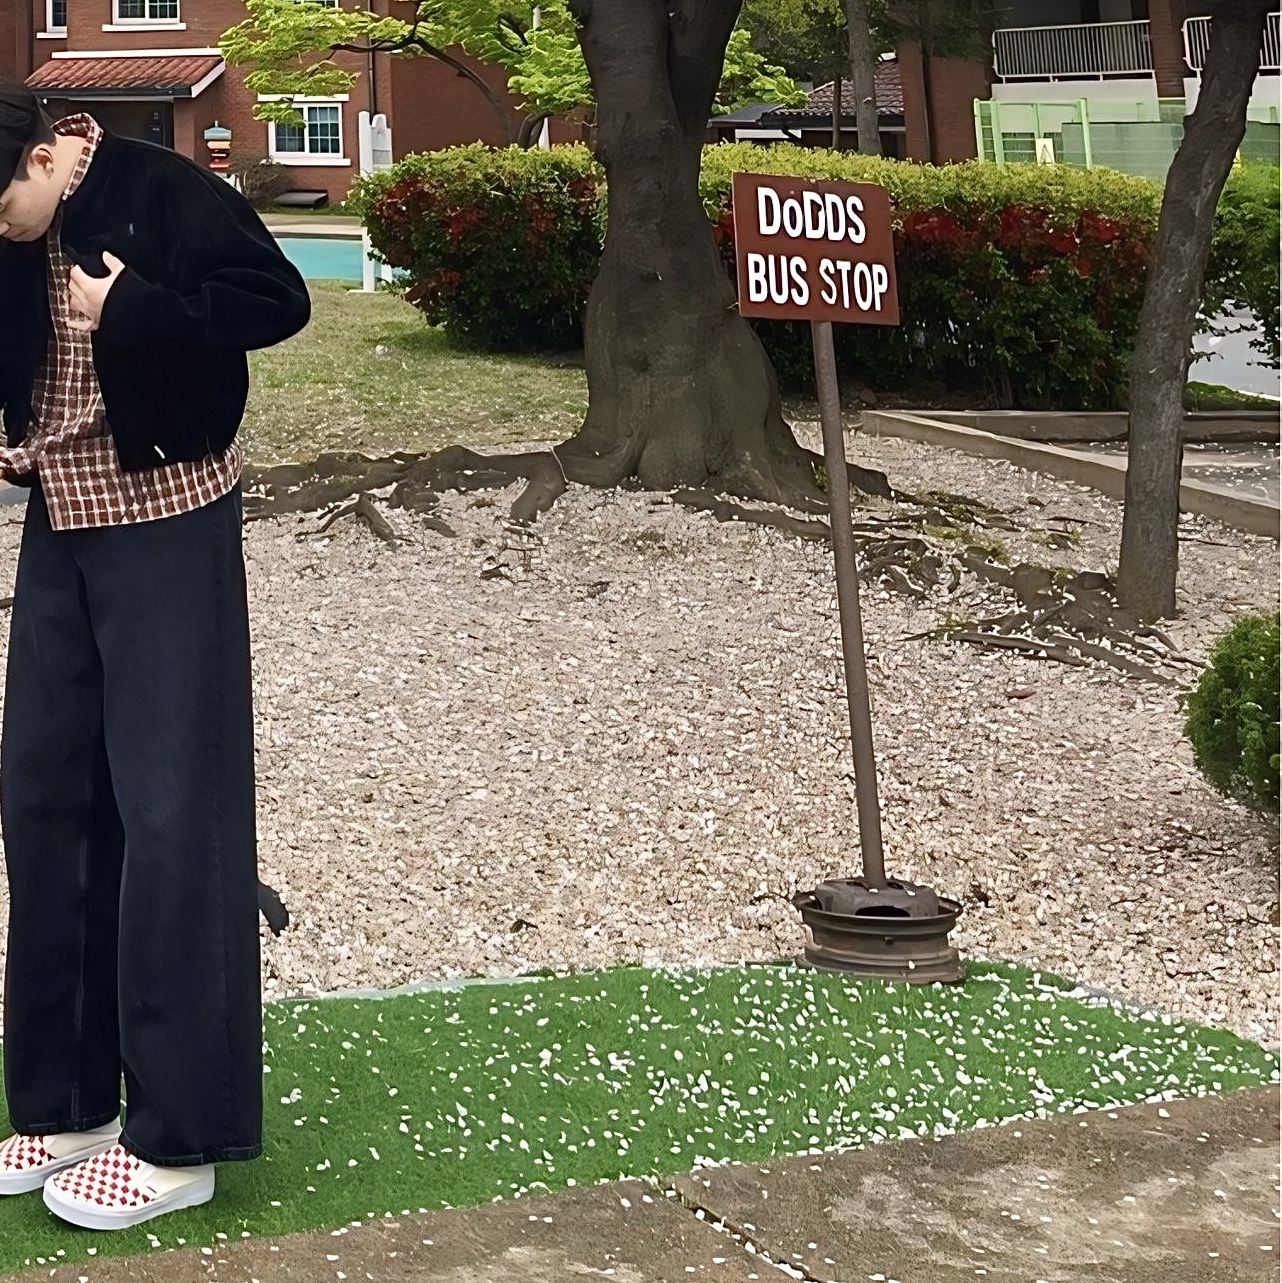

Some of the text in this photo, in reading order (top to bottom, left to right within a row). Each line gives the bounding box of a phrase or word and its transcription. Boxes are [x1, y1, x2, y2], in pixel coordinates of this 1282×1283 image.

[757, 186, 866, 244] DoDDS
[747, 253, 888, 311] BUS STOP
